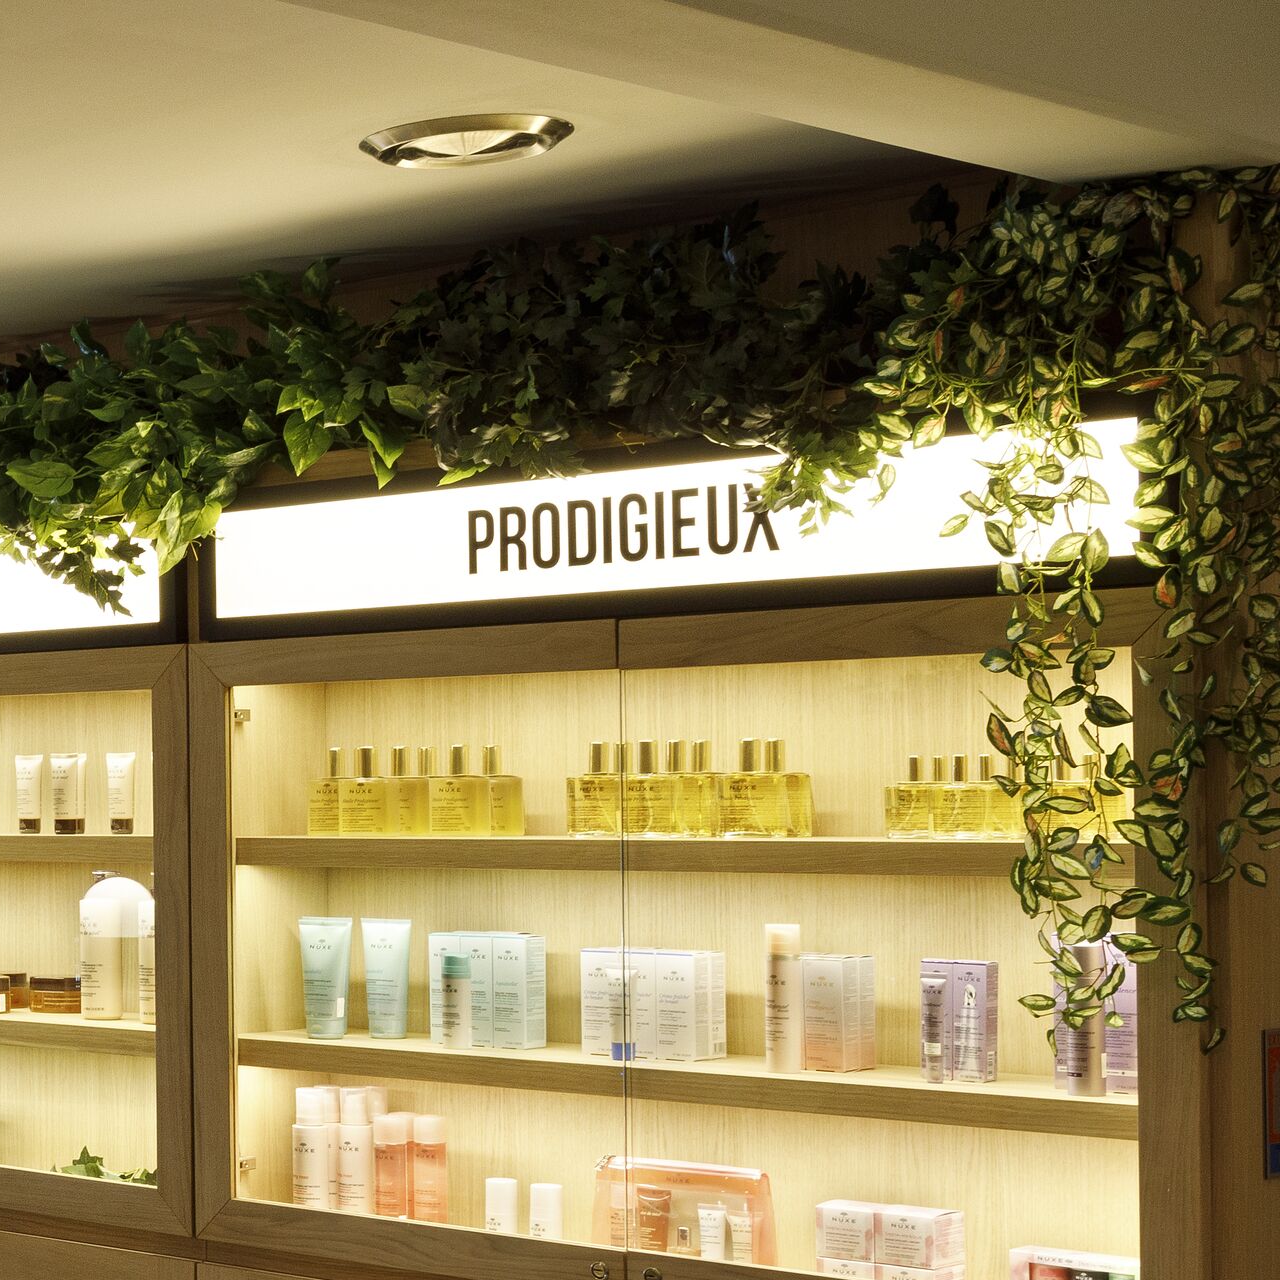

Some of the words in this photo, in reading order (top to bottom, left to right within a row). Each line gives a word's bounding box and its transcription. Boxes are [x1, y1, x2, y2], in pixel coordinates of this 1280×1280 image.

[468, 482, 780, 575] PRODIGIEUX
[1037, 1255, 1063, 1264] NUXE
[832, 1268, 857, 1276] NUXE
